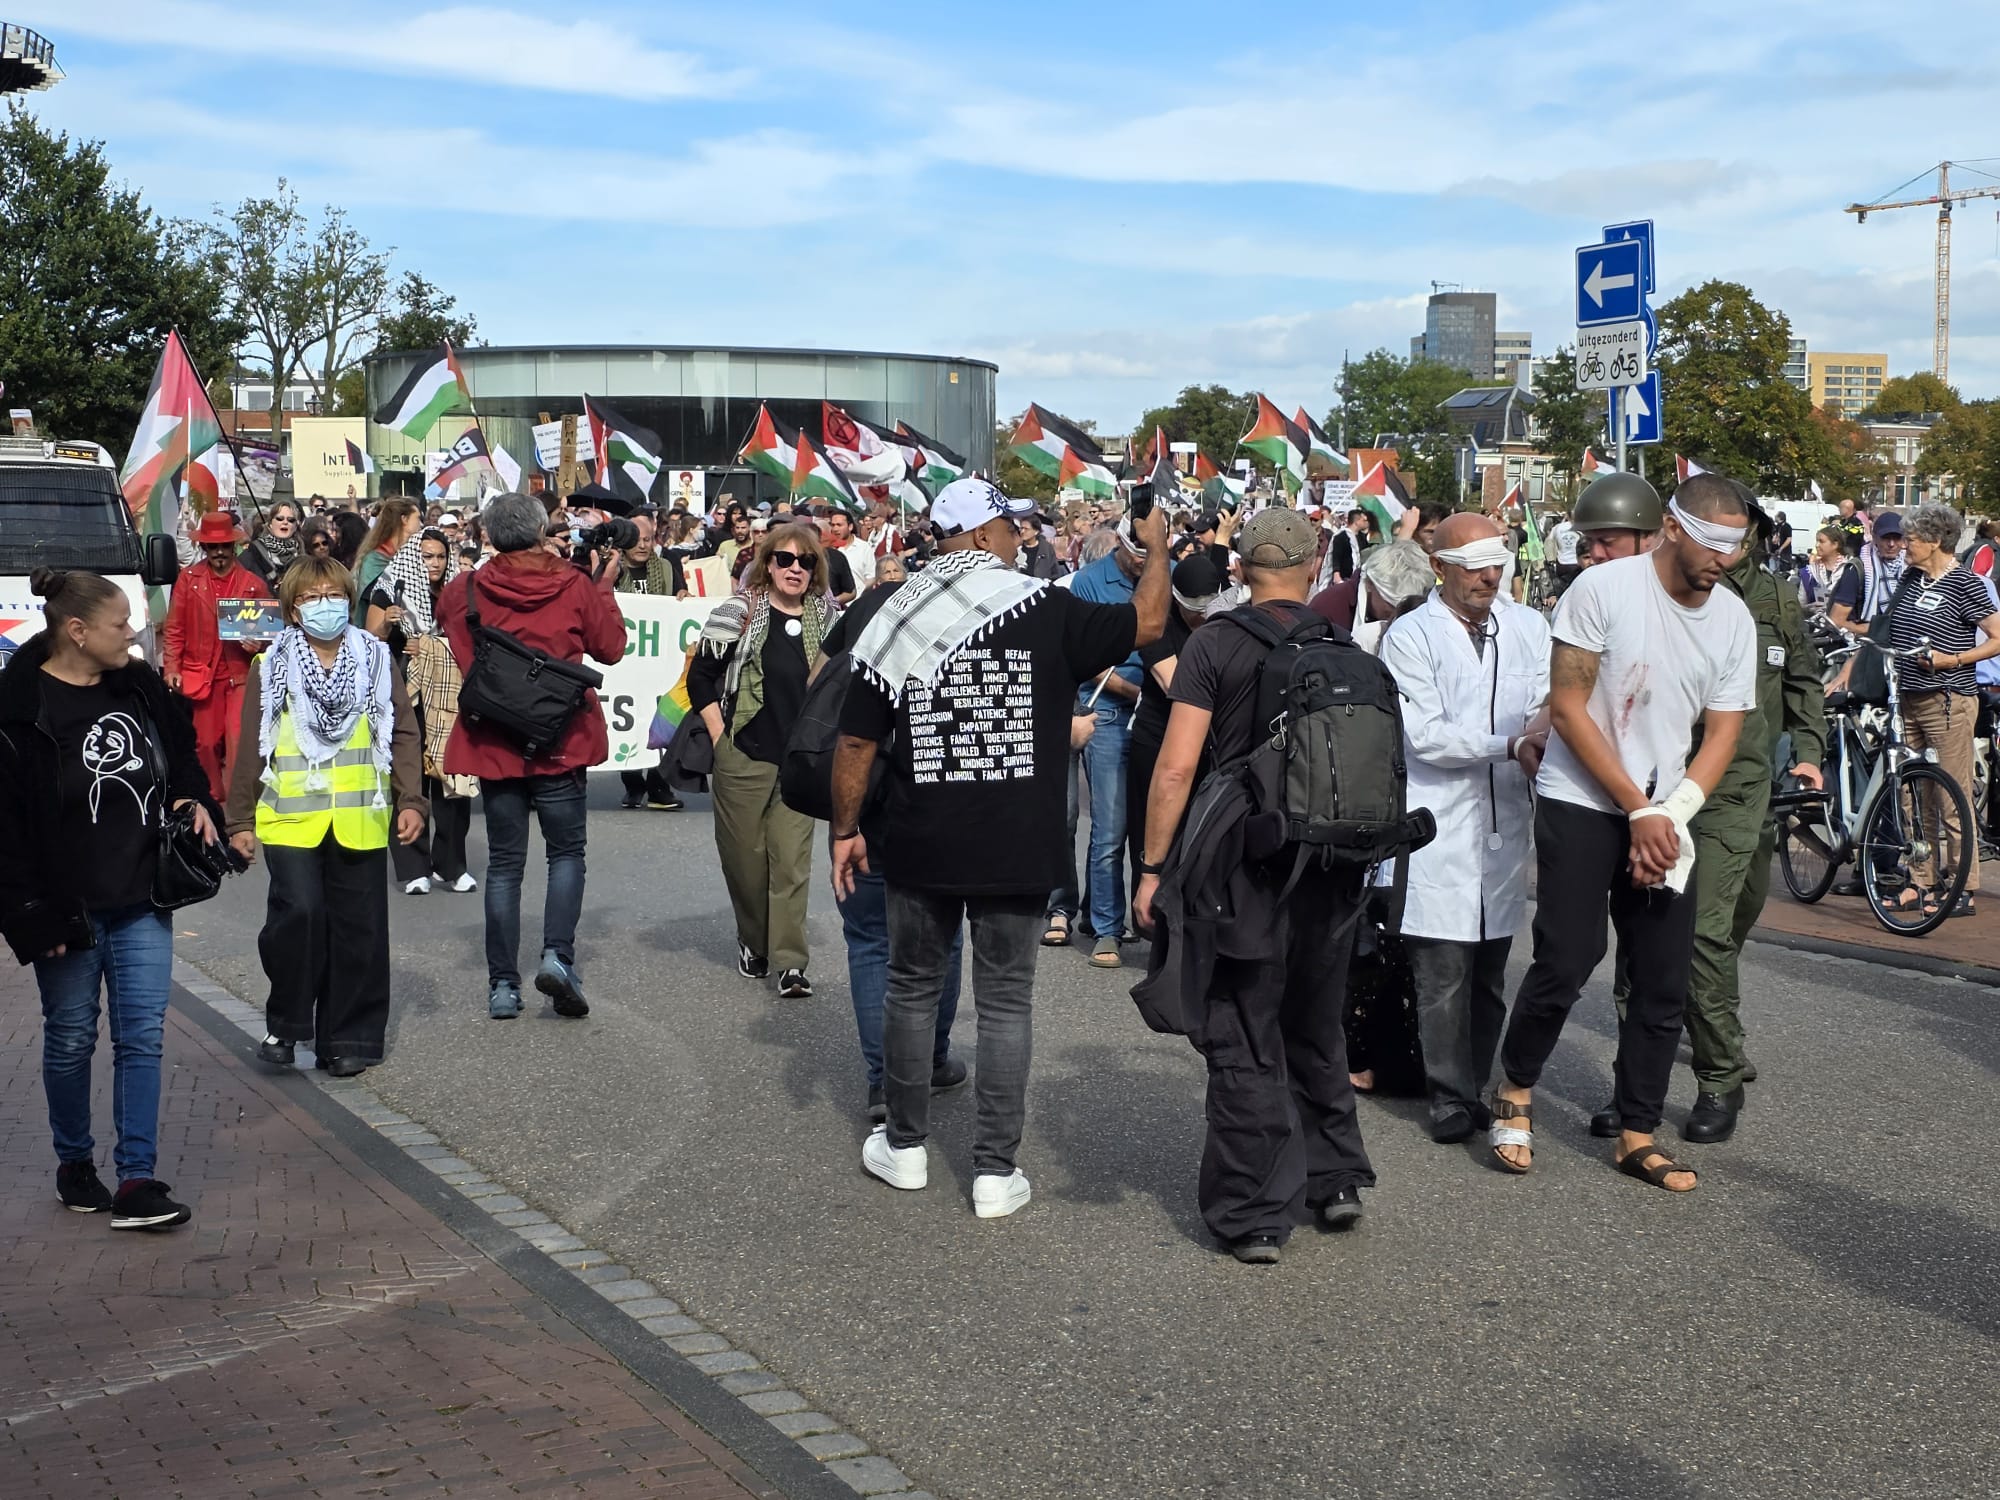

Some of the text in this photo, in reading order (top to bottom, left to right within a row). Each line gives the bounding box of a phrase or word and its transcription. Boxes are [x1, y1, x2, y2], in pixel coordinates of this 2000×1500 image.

[1579, 328, 1638, 349] uitgezonderd
[235, 607, 265, 622] NU
[958, 649, 1031, 660] COURAGE REFAAT
[953, 660, 1031, 672] HOPE HIND RAJAB
[949, 673, 972, 685] TRUTH
[983, 672, 1008, 683] AHMED
[1018, 673, 1032, 683] ABU
[908, 684, 1032, 701] ALROS RESILIENCE LOVE AYMAN
[954, 696, 993, 708] RESILIENCE
[1005, 696, 1032, 707] SHABAN
[910, 708, 1032, 725] COMPASSION PATIENCE UNITY
[911, 719, 1033, 737] KINSHIP EMPATHY LOYALTY
[912, 731, 1033, 748] PATIENCE FAMILY TOGETHERNESS
[913, 742, 1034, 760] DEFIANCE KHALED REEM TAREQ
[913, 754, 1034, 772] NABHAN KINDNESS SURVIVAL
[914, 771, 940, 783] ISMAIL
[982, 768, 1007, 781] FAMILY
[1014, 765, 1034, 778] GRACE
